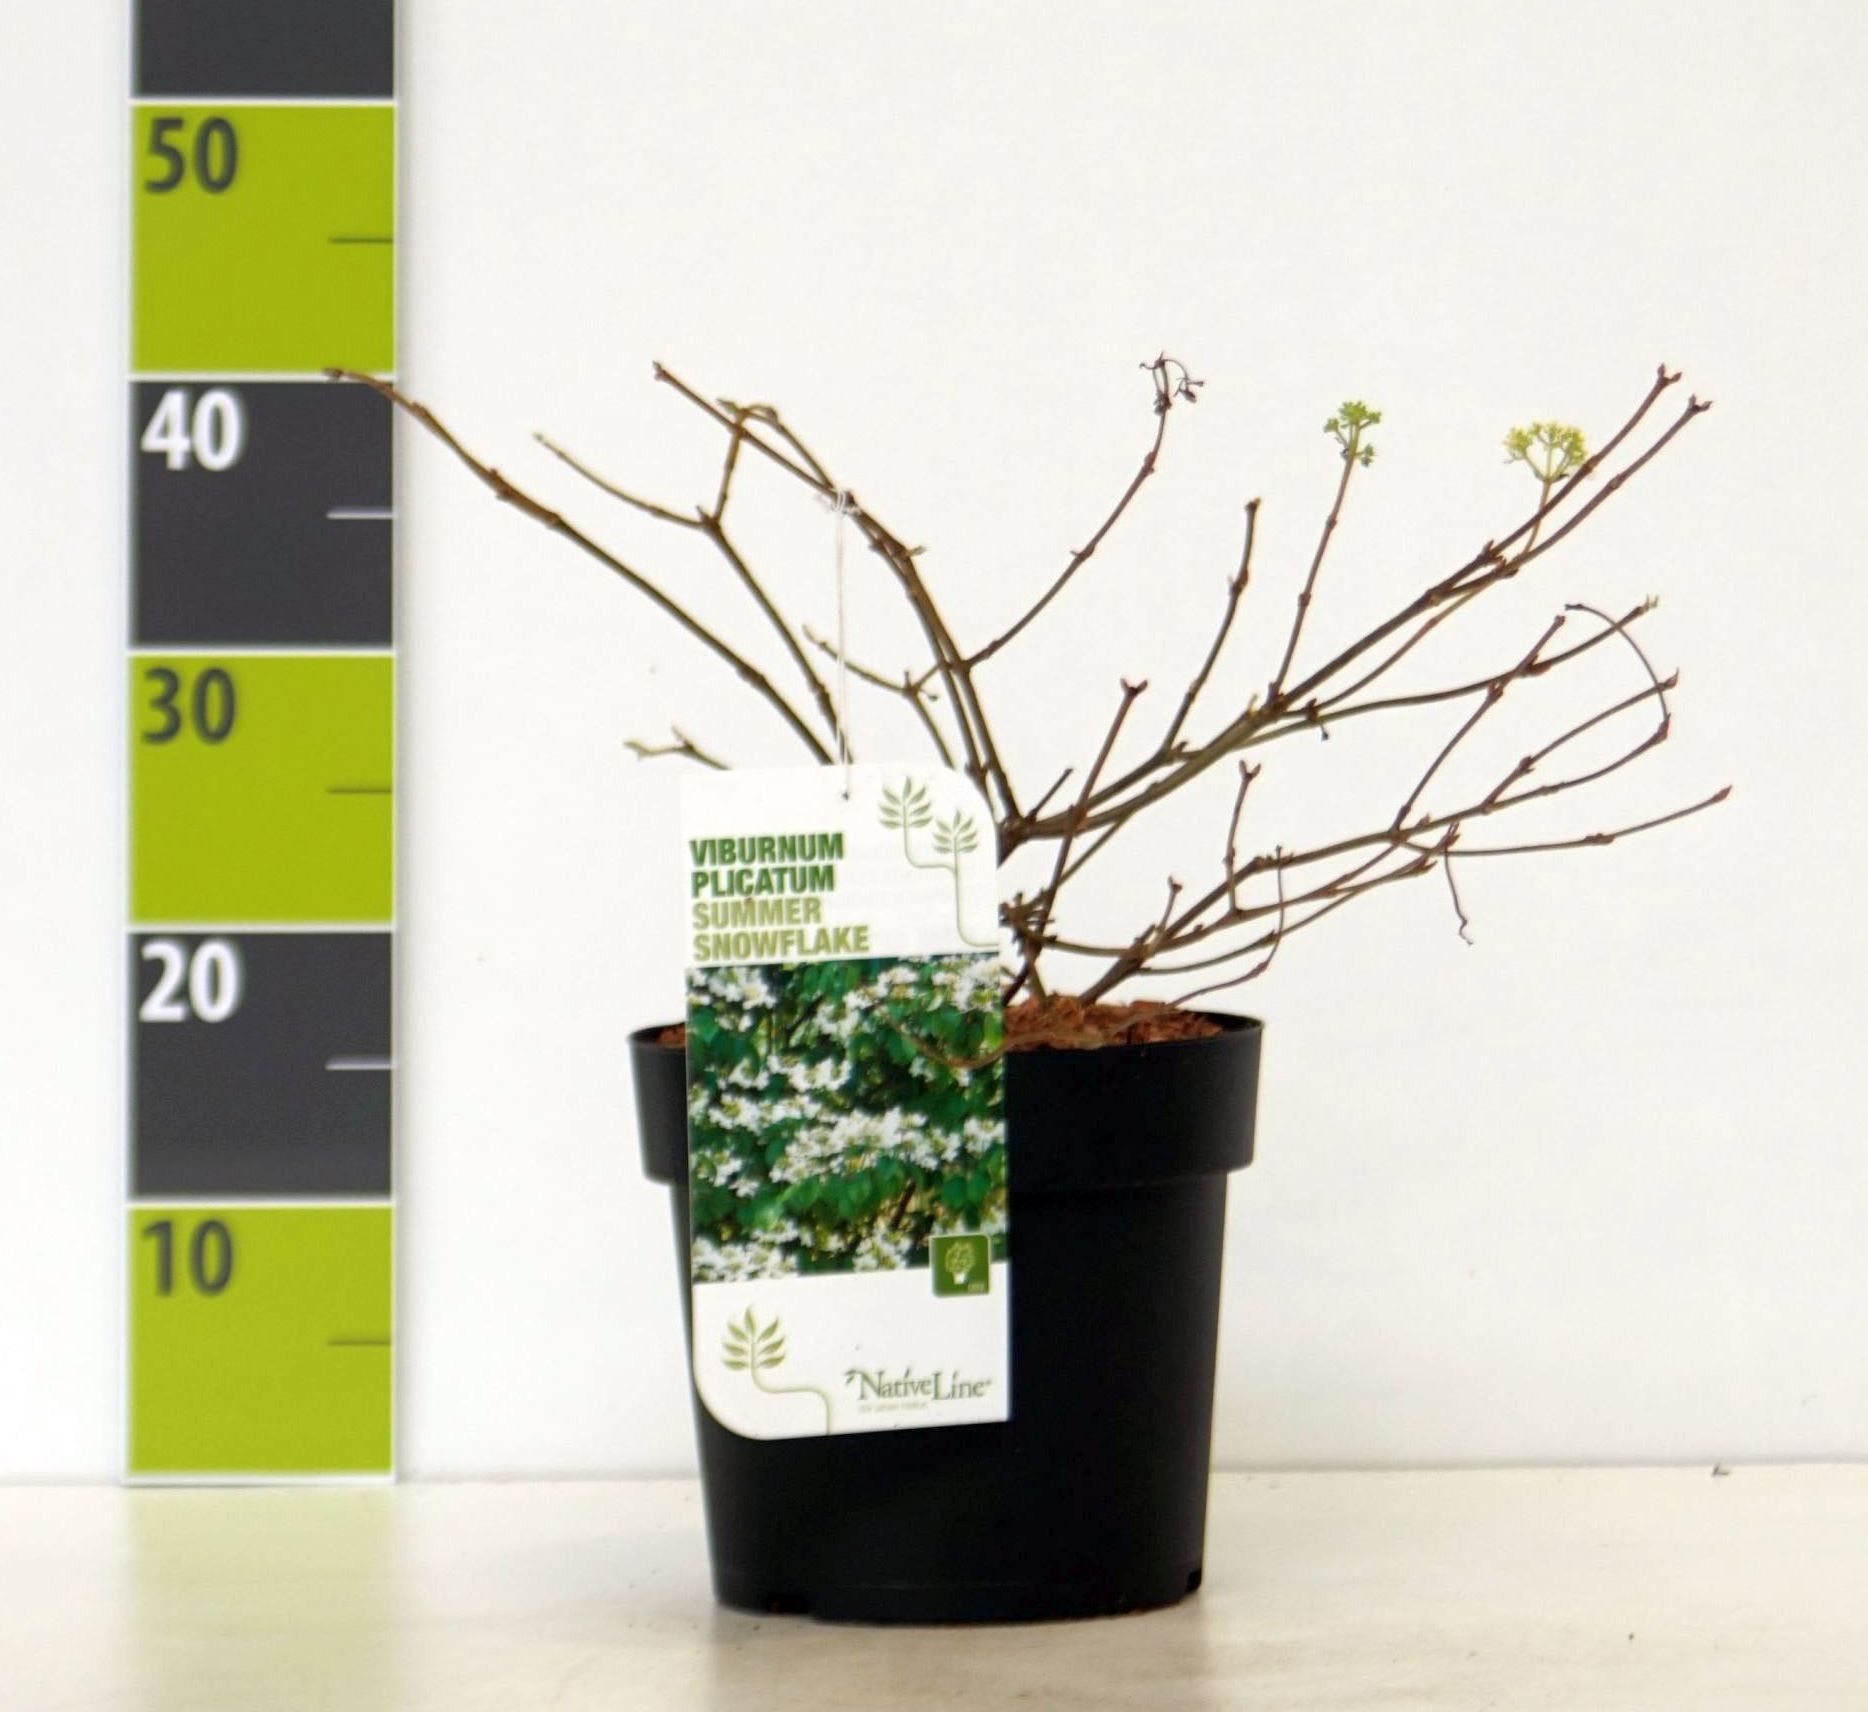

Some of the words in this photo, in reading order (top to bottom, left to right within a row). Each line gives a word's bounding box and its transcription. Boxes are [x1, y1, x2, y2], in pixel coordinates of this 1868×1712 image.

[143, 117, 237, 193] 50
[141, 391, 242, 470] 40
[142, 668, 237, 743] 30
[690, 833, 844, 866] VIBURNUM
[692, 865, 835, 897] PLICATUM
[693, 899, 822, 929] SUMMER
[694, 927, 870, 961] SNOWFLAKE
[141, 941, 240, 1022] 20
[142, 1221, 234, 1295] 10
